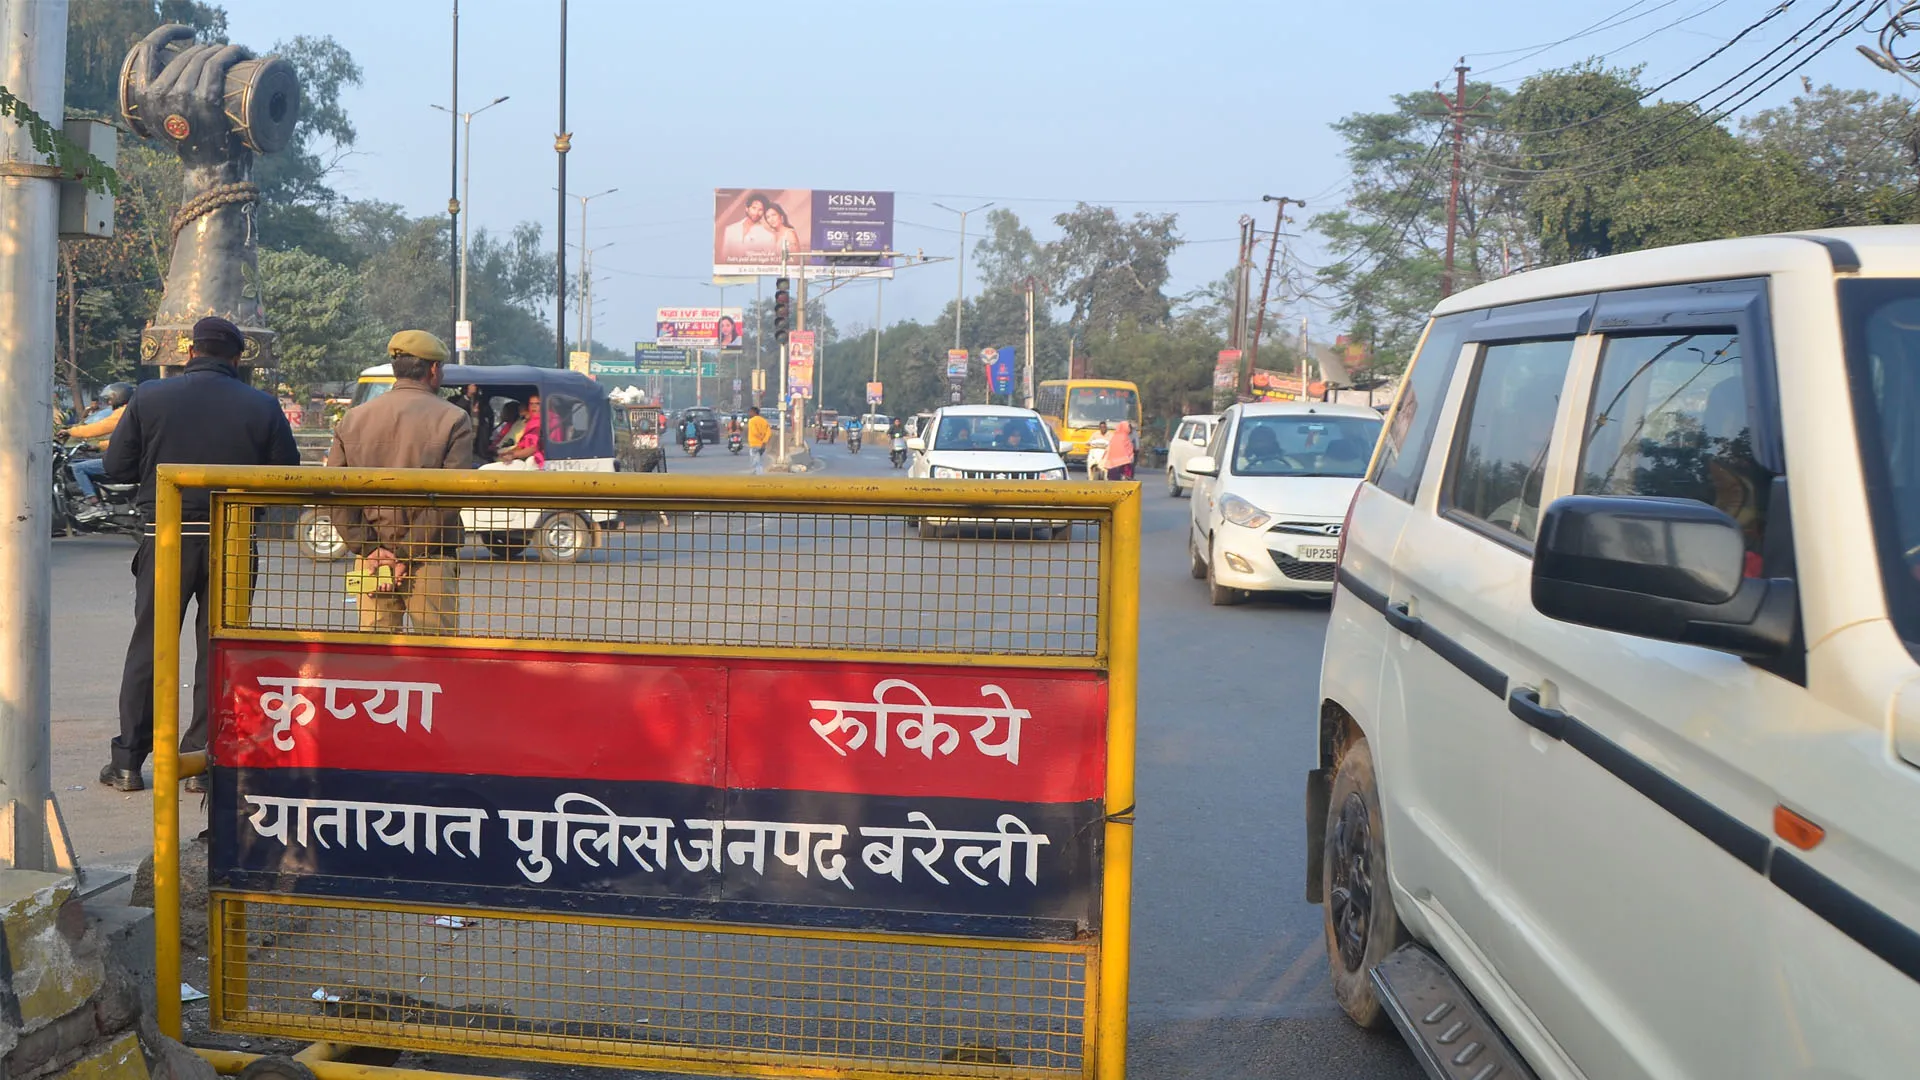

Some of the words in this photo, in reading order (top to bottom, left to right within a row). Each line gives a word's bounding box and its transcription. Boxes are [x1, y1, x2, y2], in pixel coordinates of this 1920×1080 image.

[828, 194, 876, 206] KISNA
[826, 230, 849, 241] 50%
[855, 231, 877, 241] 25%
[674, 322, 691, 330] IVF
[257, 676, 442, 751] कृप्या
[245, 795, 488, 859] यातायात
[498, 792, 674, 883] पुलिस
[674, 818, 854, 890] जनपद
[859, 811, 1050, 886] बरेली
